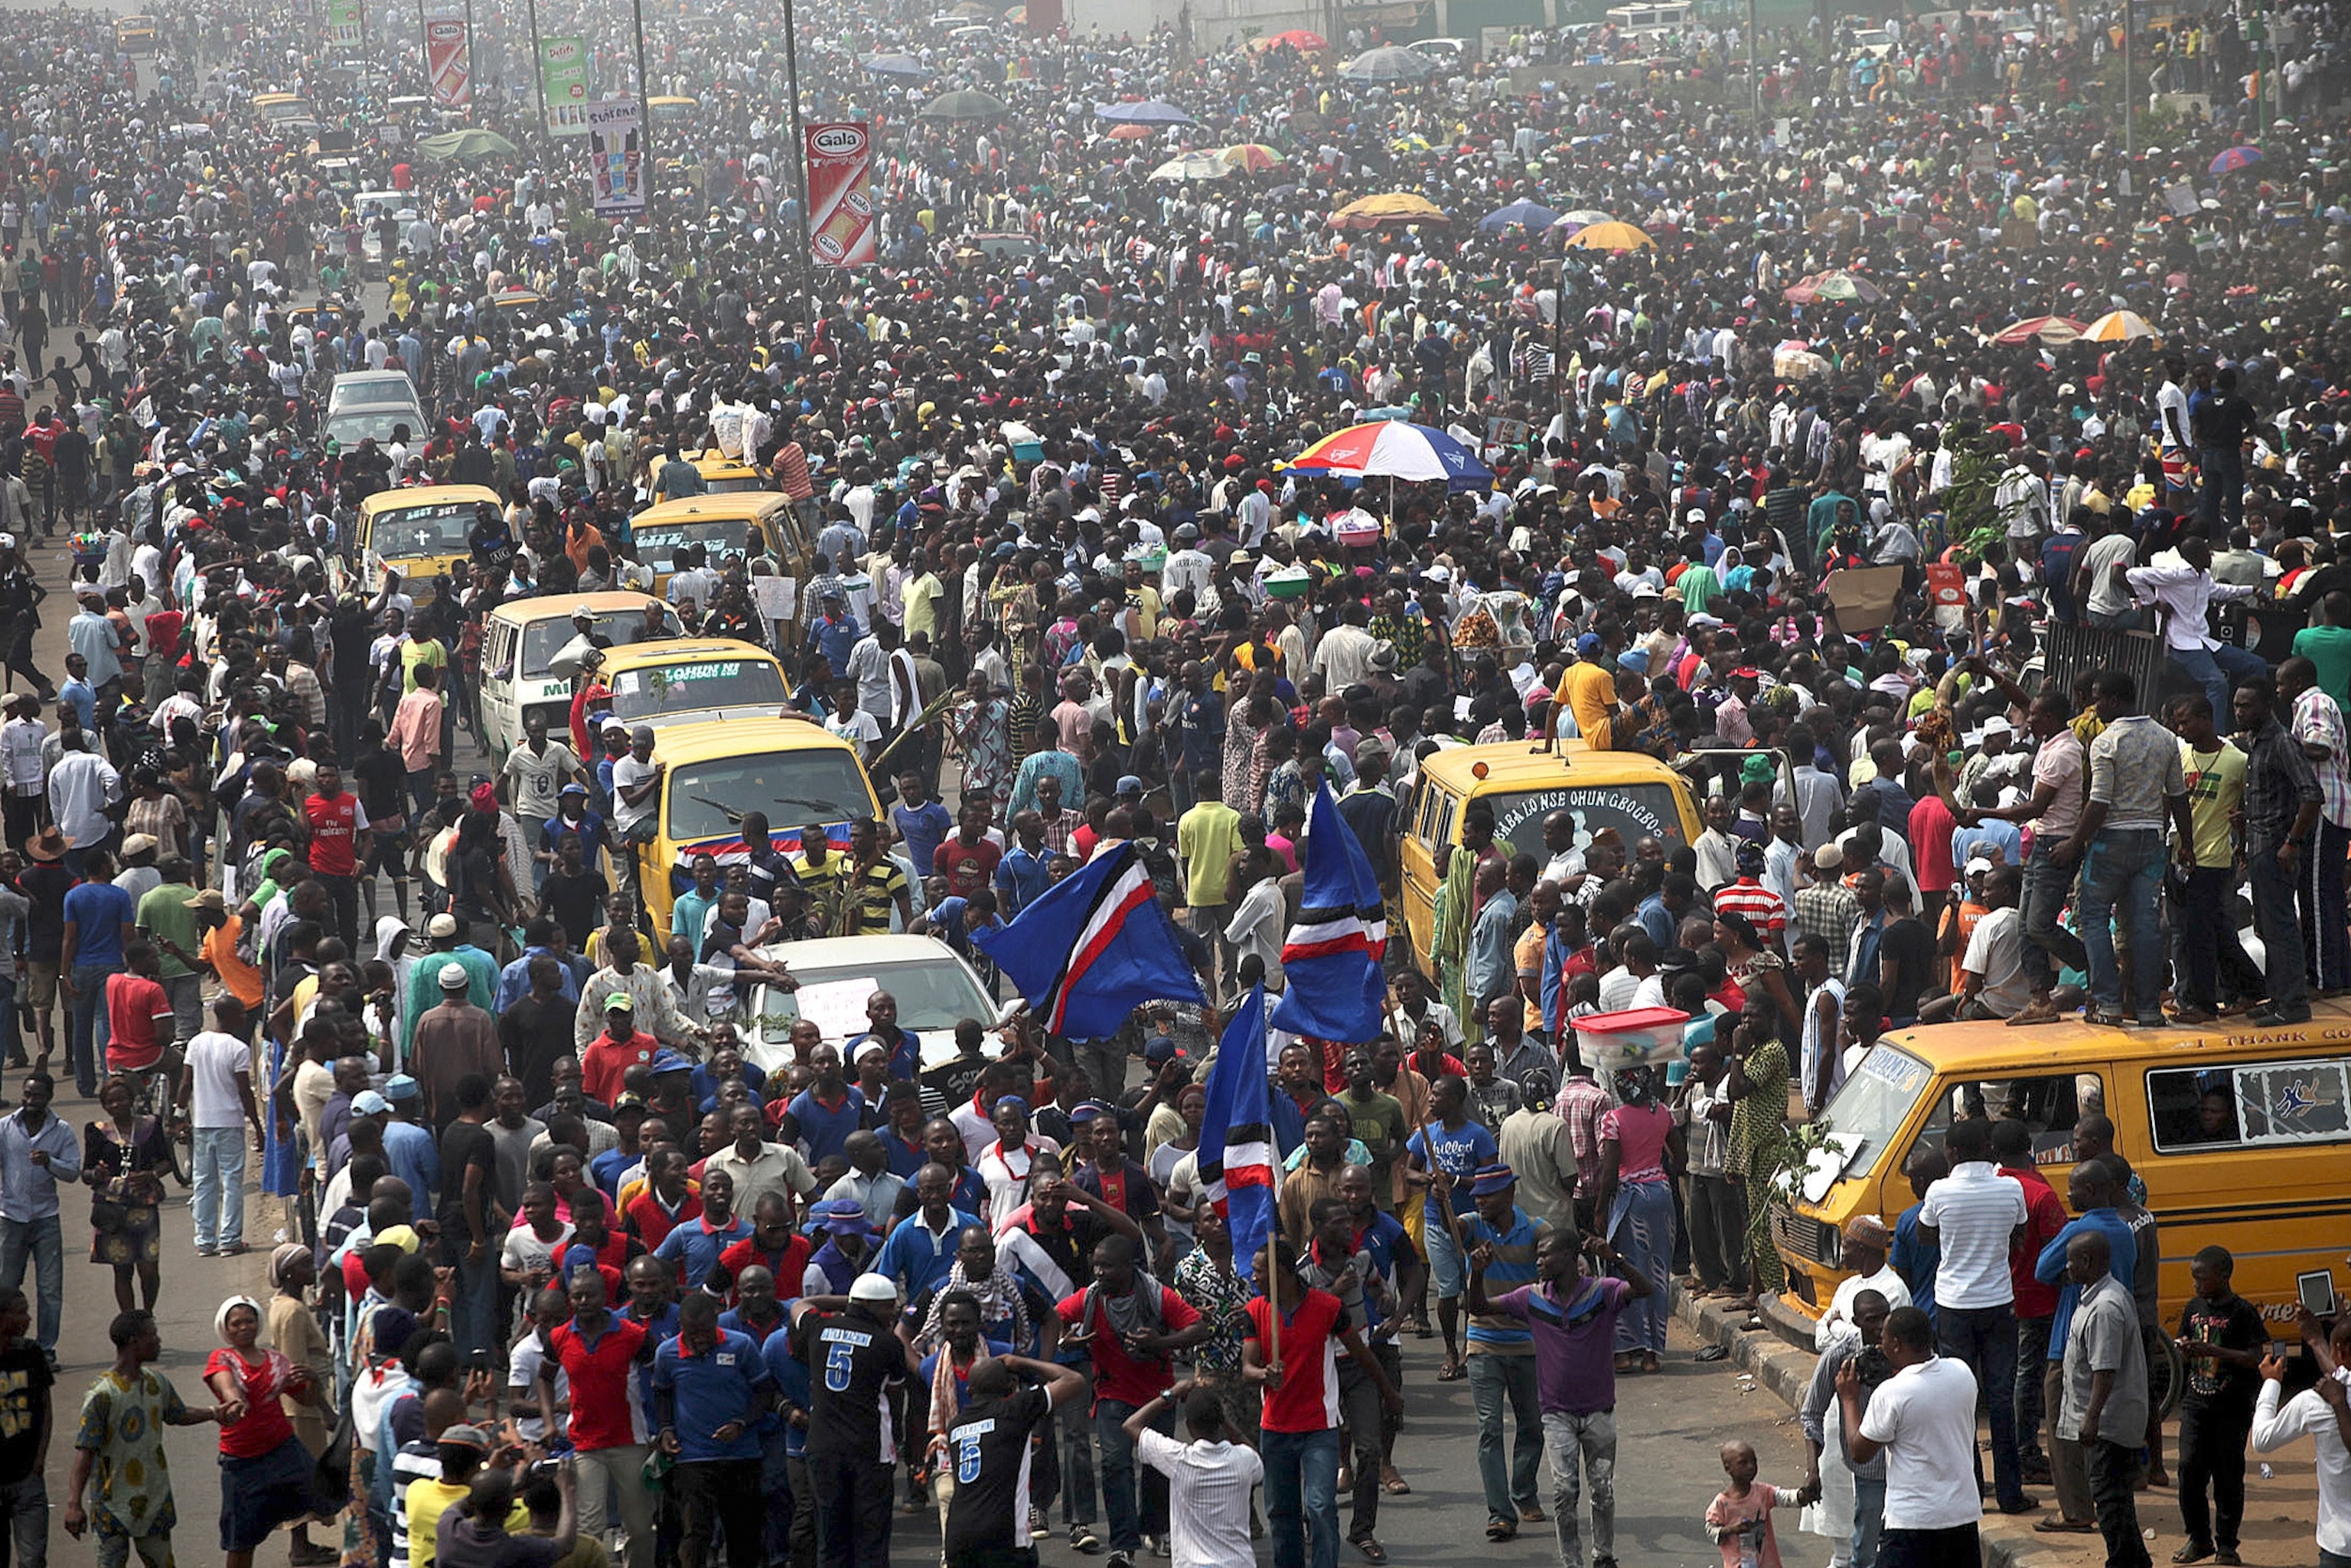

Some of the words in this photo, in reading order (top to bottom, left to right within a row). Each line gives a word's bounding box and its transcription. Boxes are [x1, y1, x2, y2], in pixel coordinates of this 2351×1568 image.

[817, 132, 857, 147] Gala
[849, 194, 869, 212] Gala
[820, 236, 840, 255] Gala
[1332, 377, 1343, 392] 12
[1492, 809, 1524, 841] BABA
[1522, 797, 1538, 817] LO
[1539, 791, 1567, 811] NSE
[1570, 790, 1606, 807] OHUN
[1608, 793, 1660, 830] GBOGBO
[2196, 1038, 2205, 1048] I
[2223, 1031, 2309, 1048] THANK
[825, 1341, 855, 1393] 5
[958, 1433, 982, 1484] 5
